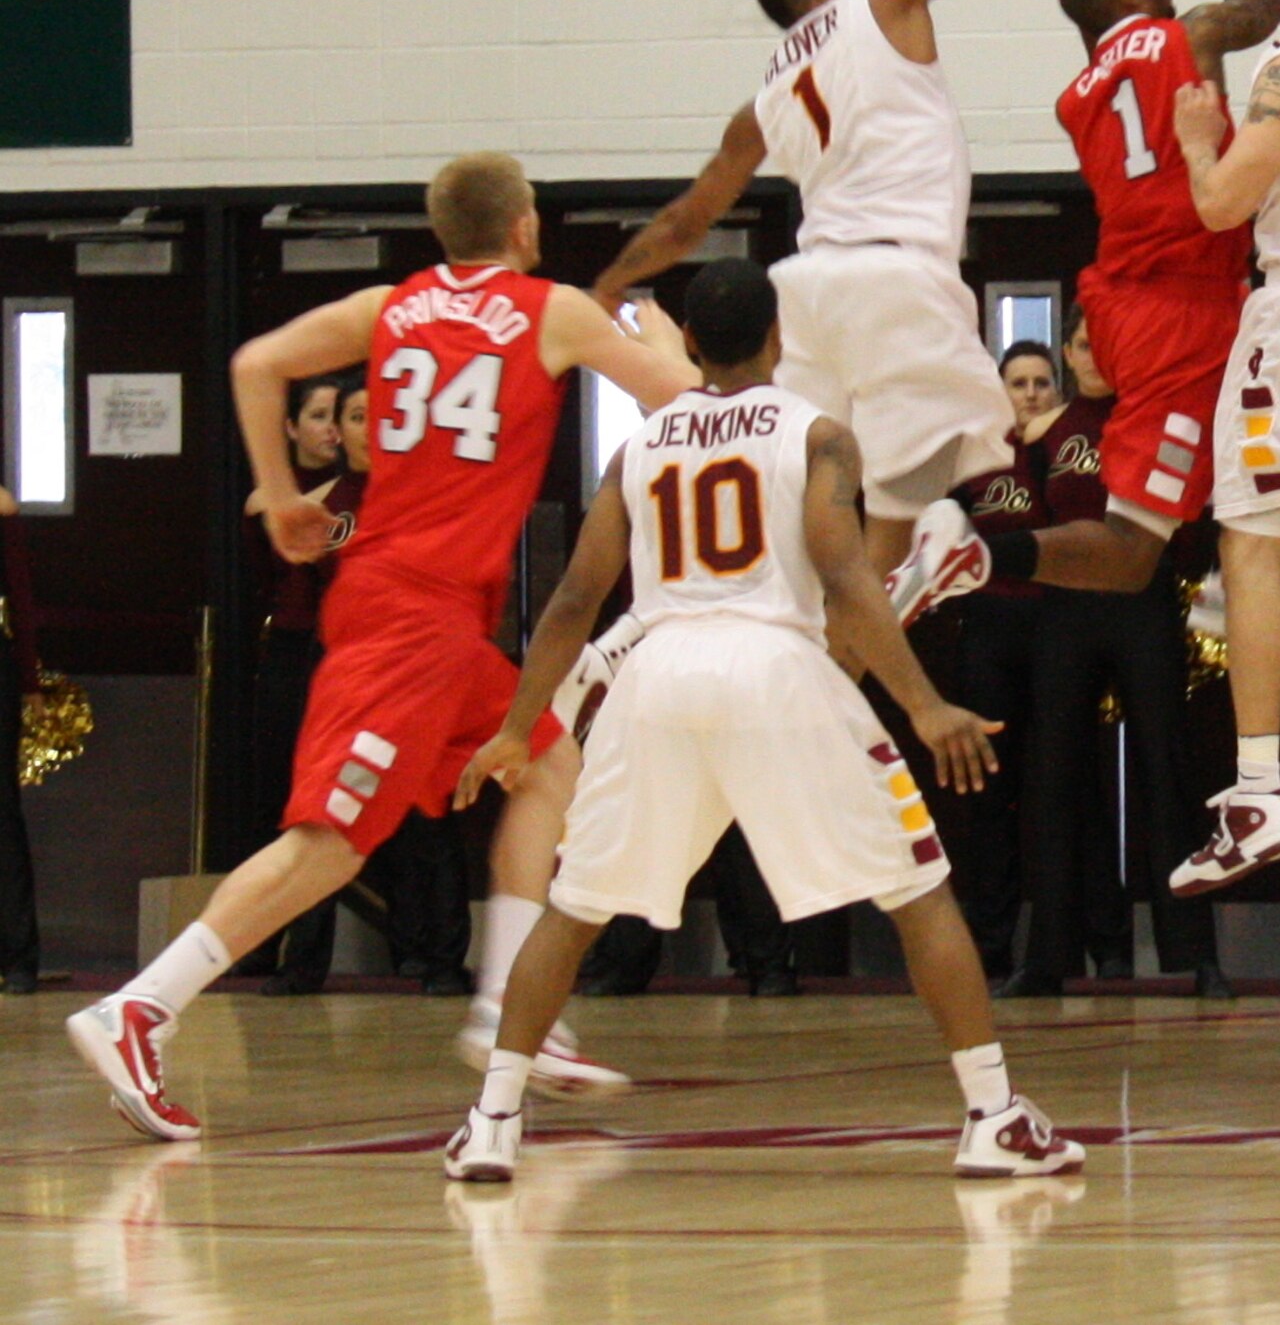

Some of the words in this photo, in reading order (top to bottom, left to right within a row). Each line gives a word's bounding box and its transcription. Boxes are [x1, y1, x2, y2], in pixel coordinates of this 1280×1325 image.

[791, 65, 833, 153] 1
[1111, 77, 1159, 181] 1
[379, 346, 504, 463] 34
[646, 404, 781, 449] JENKINS
[647, 454, 768, 583] 10
